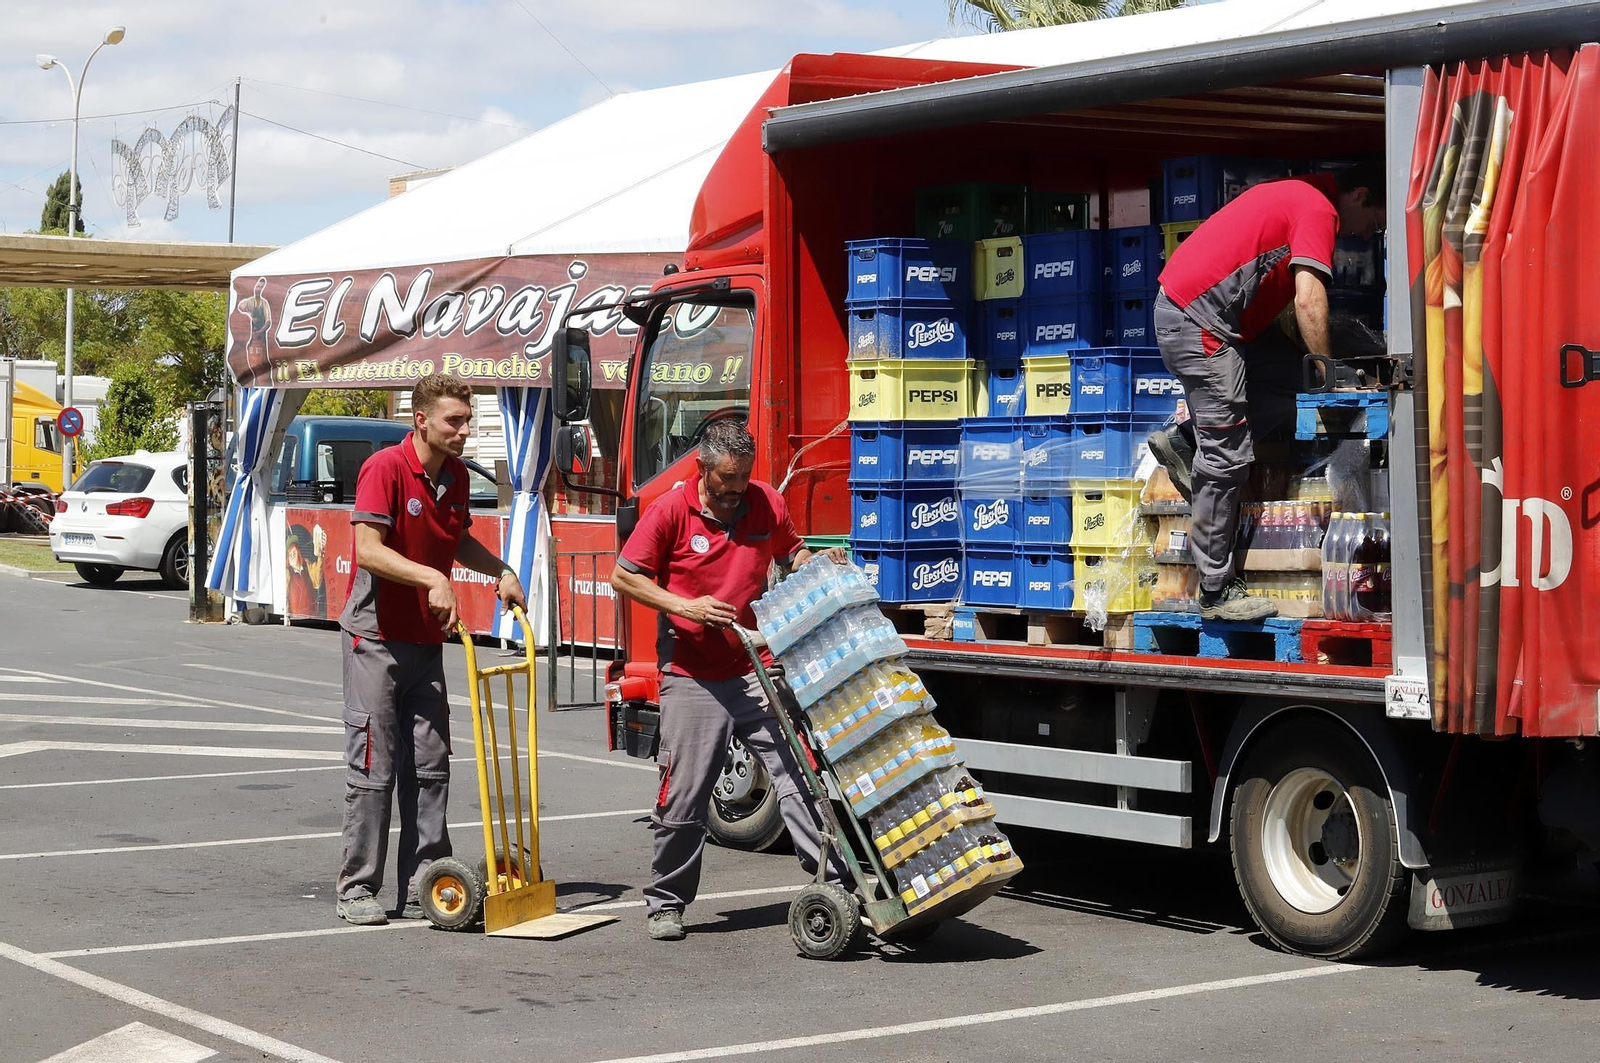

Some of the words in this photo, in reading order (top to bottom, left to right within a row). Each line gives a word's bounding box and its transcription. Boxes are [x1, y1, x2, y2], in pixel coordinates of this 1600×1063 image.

[1173, 194, 1197, 205] PEPSI
[906, 265, 957, 283] PEPSI
[1034, 260, 1074, 278] PEPSI
[856, 273, 877, 284] PEPSI
[274, 276, 354, 349] El
[997, 331, 1016, 341] PEPSI
[1035, 323, 1075, 341] PEPSI
[1123, 327, 1144, 337] PEPSI
[295, 359, 323, 383] El
[440, 352, 542, 380] Ponche
[1036, 383, 1071, 397] PEPS
[1081, 385, 1103, 395] PEPSI
[1135, 378, 1184, 395] PEPS
[909, 390, 958, 403] PEPSI
[908, 450, 958, 465] PEPSI
[973, 443, 1010, 460] PEPSI
[1081, 450, 1104, 460] PEPSI
[858, 456, 878, 465] PEPSI
[1027, 516, 1050, 526] PEPSI
[973, 571, 1012, 588] PEPSI
[1029, 581, 1051, 591] PEPSI
[1431, 877, 1513, 909] GONZALEZ
